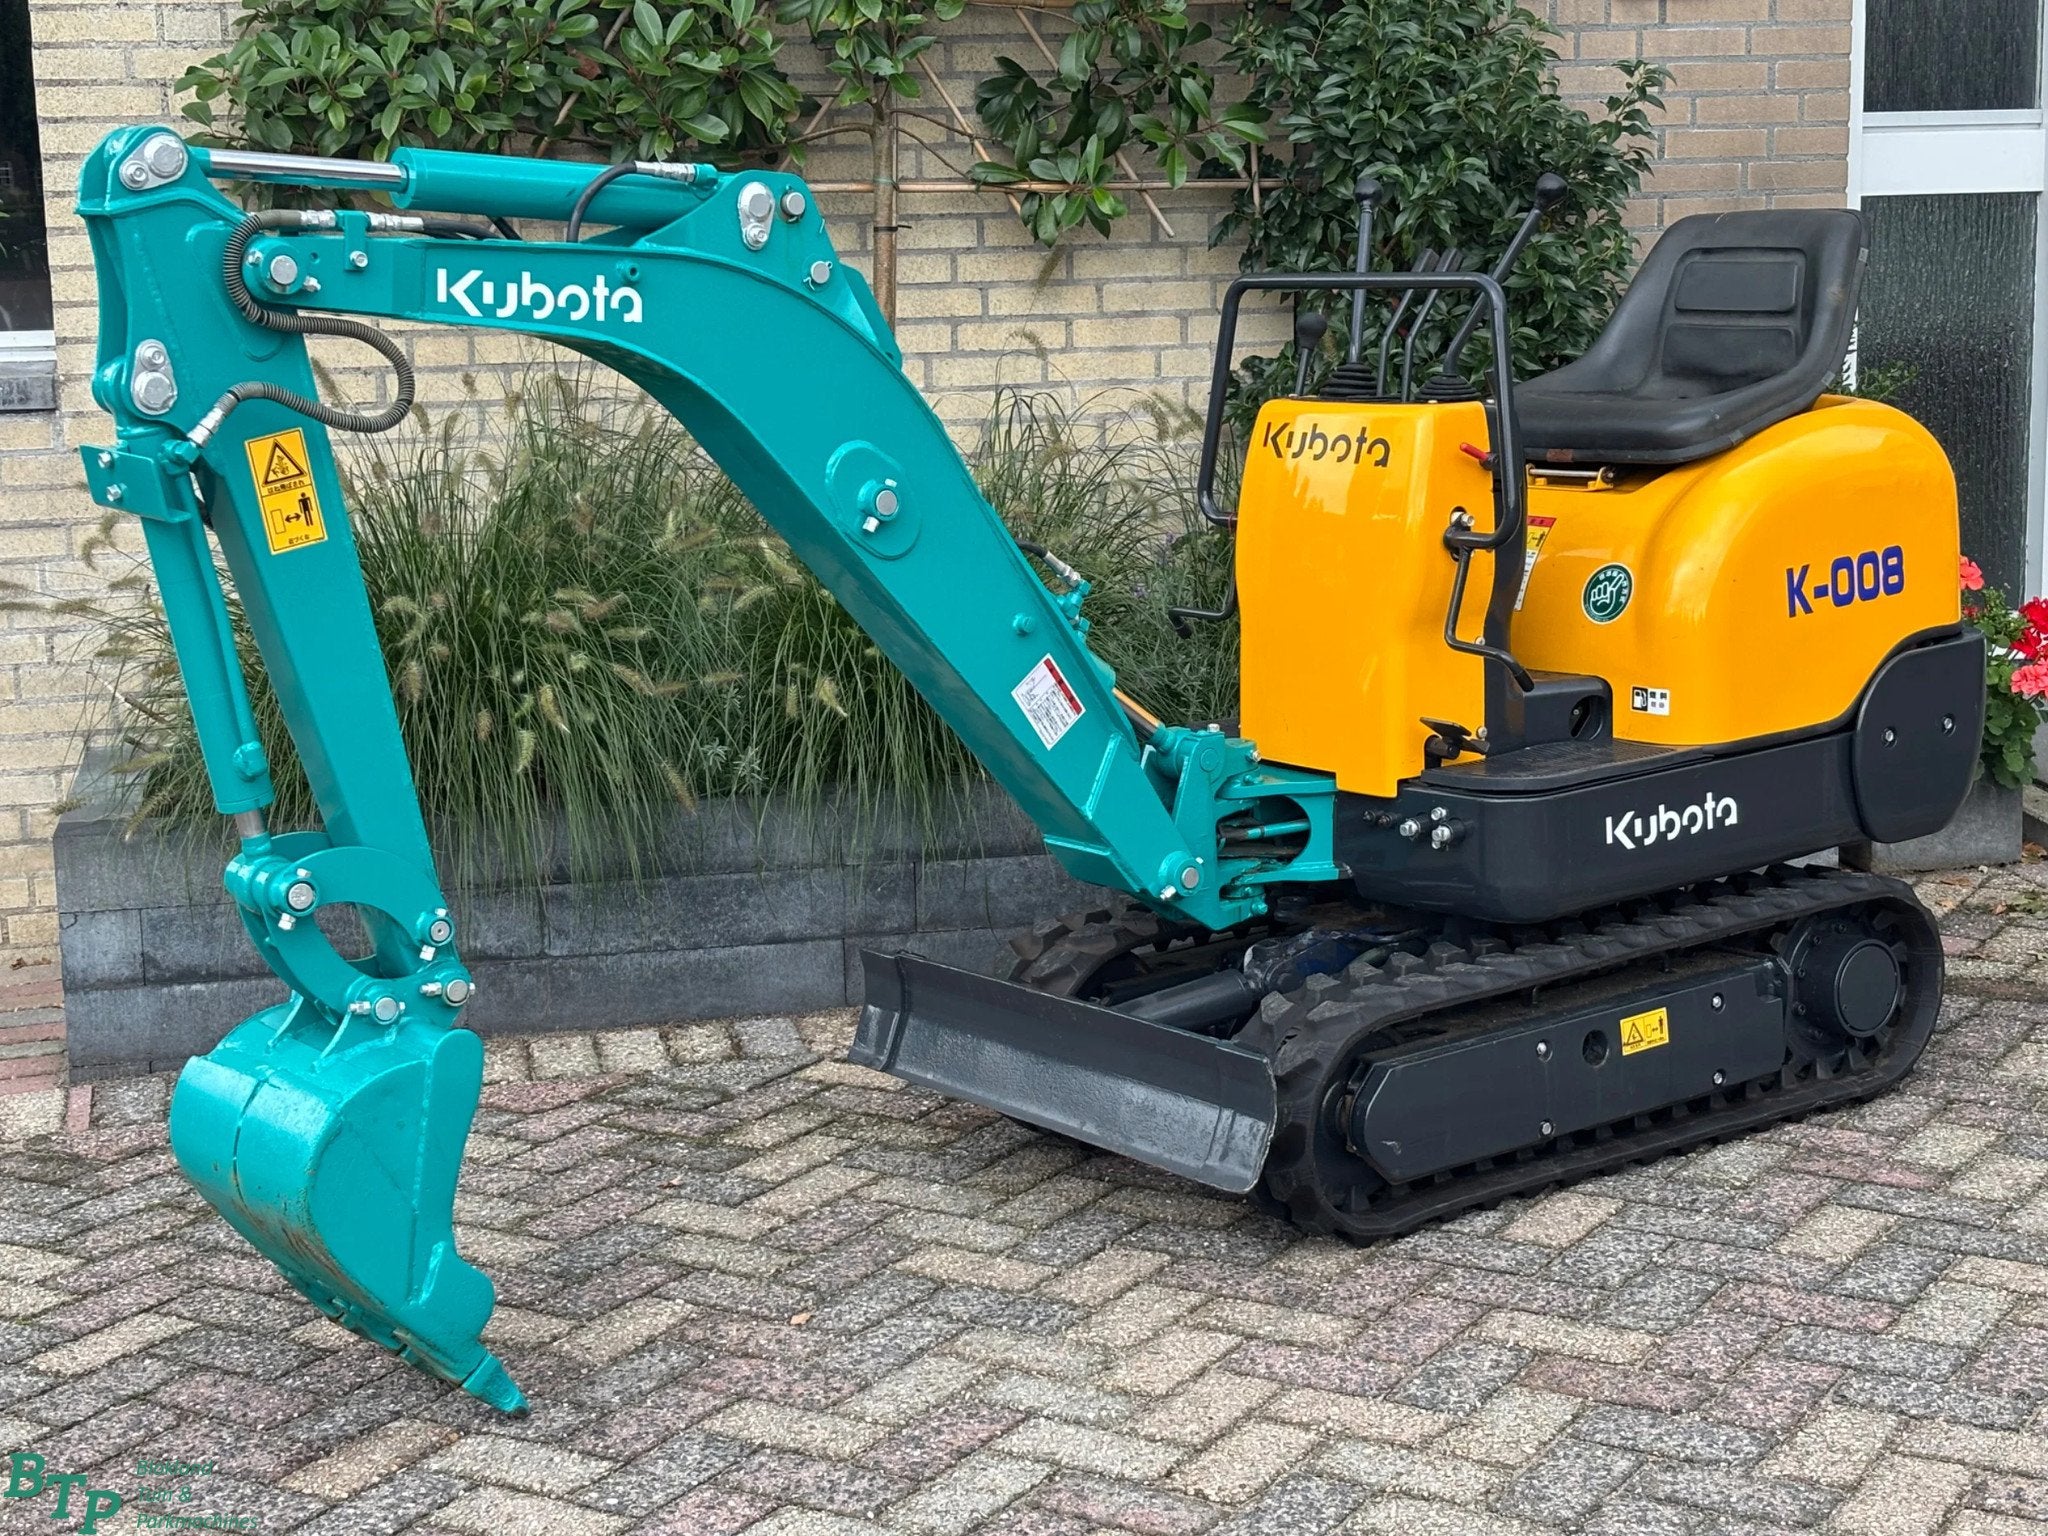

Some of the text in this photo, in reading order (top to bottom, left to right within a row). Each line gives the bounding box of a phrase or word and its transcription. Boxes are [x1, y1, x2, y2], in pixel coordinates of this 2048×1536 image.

[437, 268, 643, 323] Kubota
[1263, 421, 1391, 468] Kubota
[1786, 545, 1905, 618] K-008
[1605, 791, 1738, 850] Kubota
